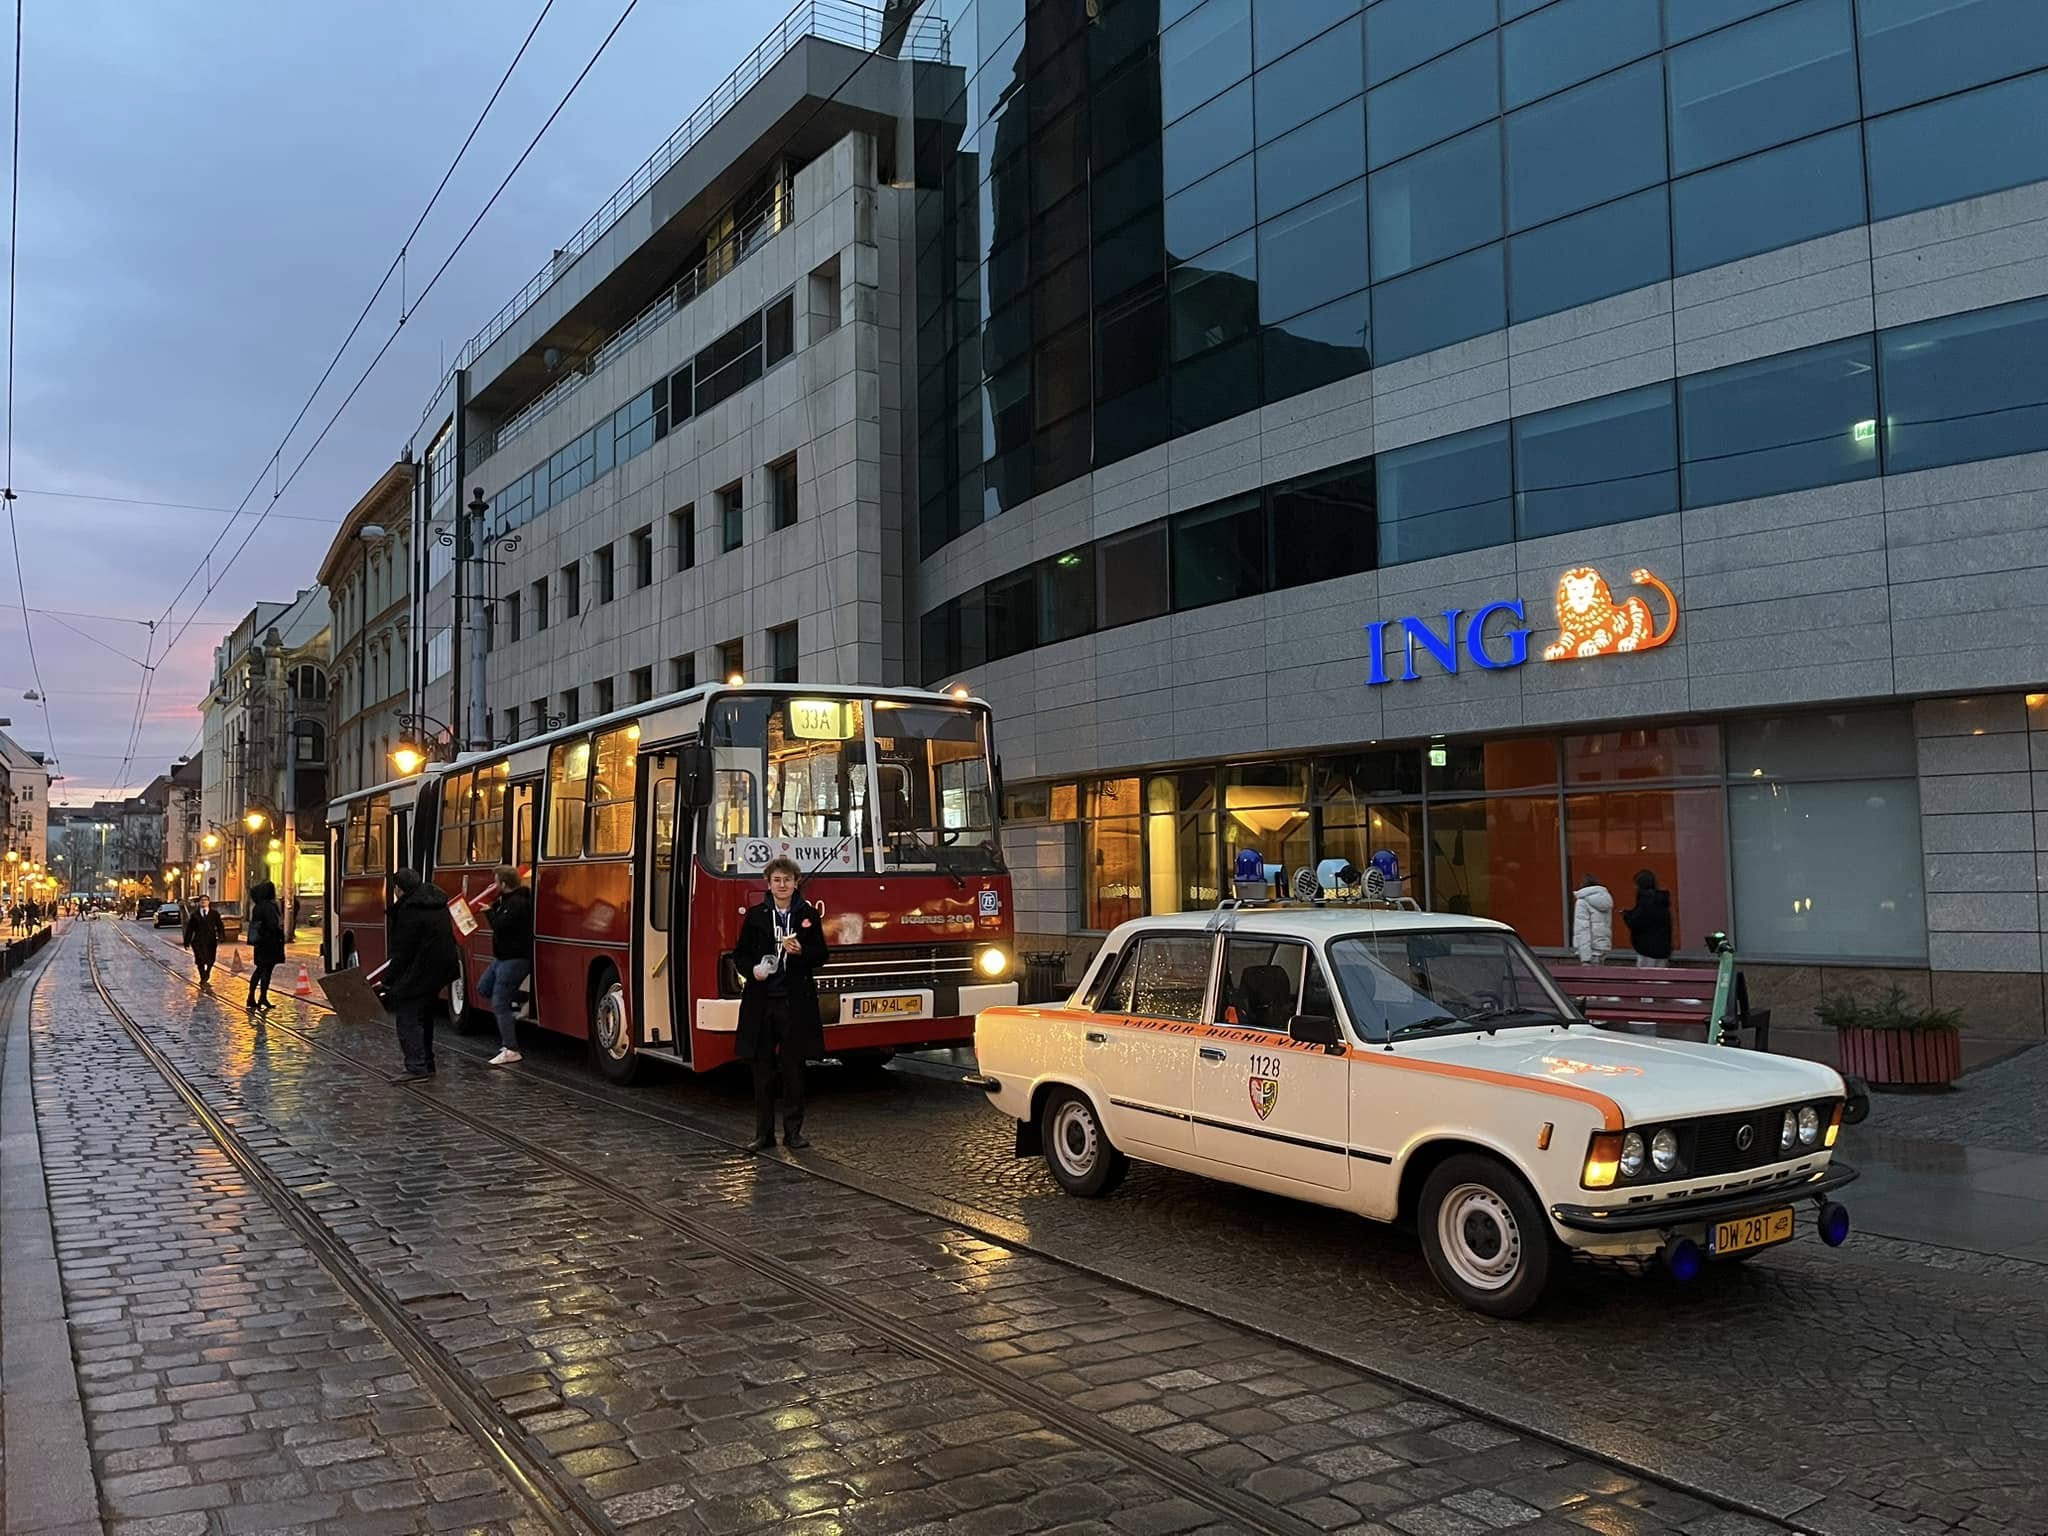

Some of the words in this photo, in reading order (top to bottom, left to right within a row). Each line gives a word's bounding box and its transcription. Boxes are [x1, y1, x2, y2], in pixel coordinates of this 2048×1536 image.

[1364, 598, 1532, 685] ING
[801, 708, 831, 730] 33A
[749, 845, 770, 863] 33
[862, 1000, 878, 1014] DW
[881, 998, 903, 1012] 94L
[1250, 1054, 1281, 1078] 1128
[1719, 1223, 1739, 1251] DW
[1744, 1216, 1772, 1245] 28T
